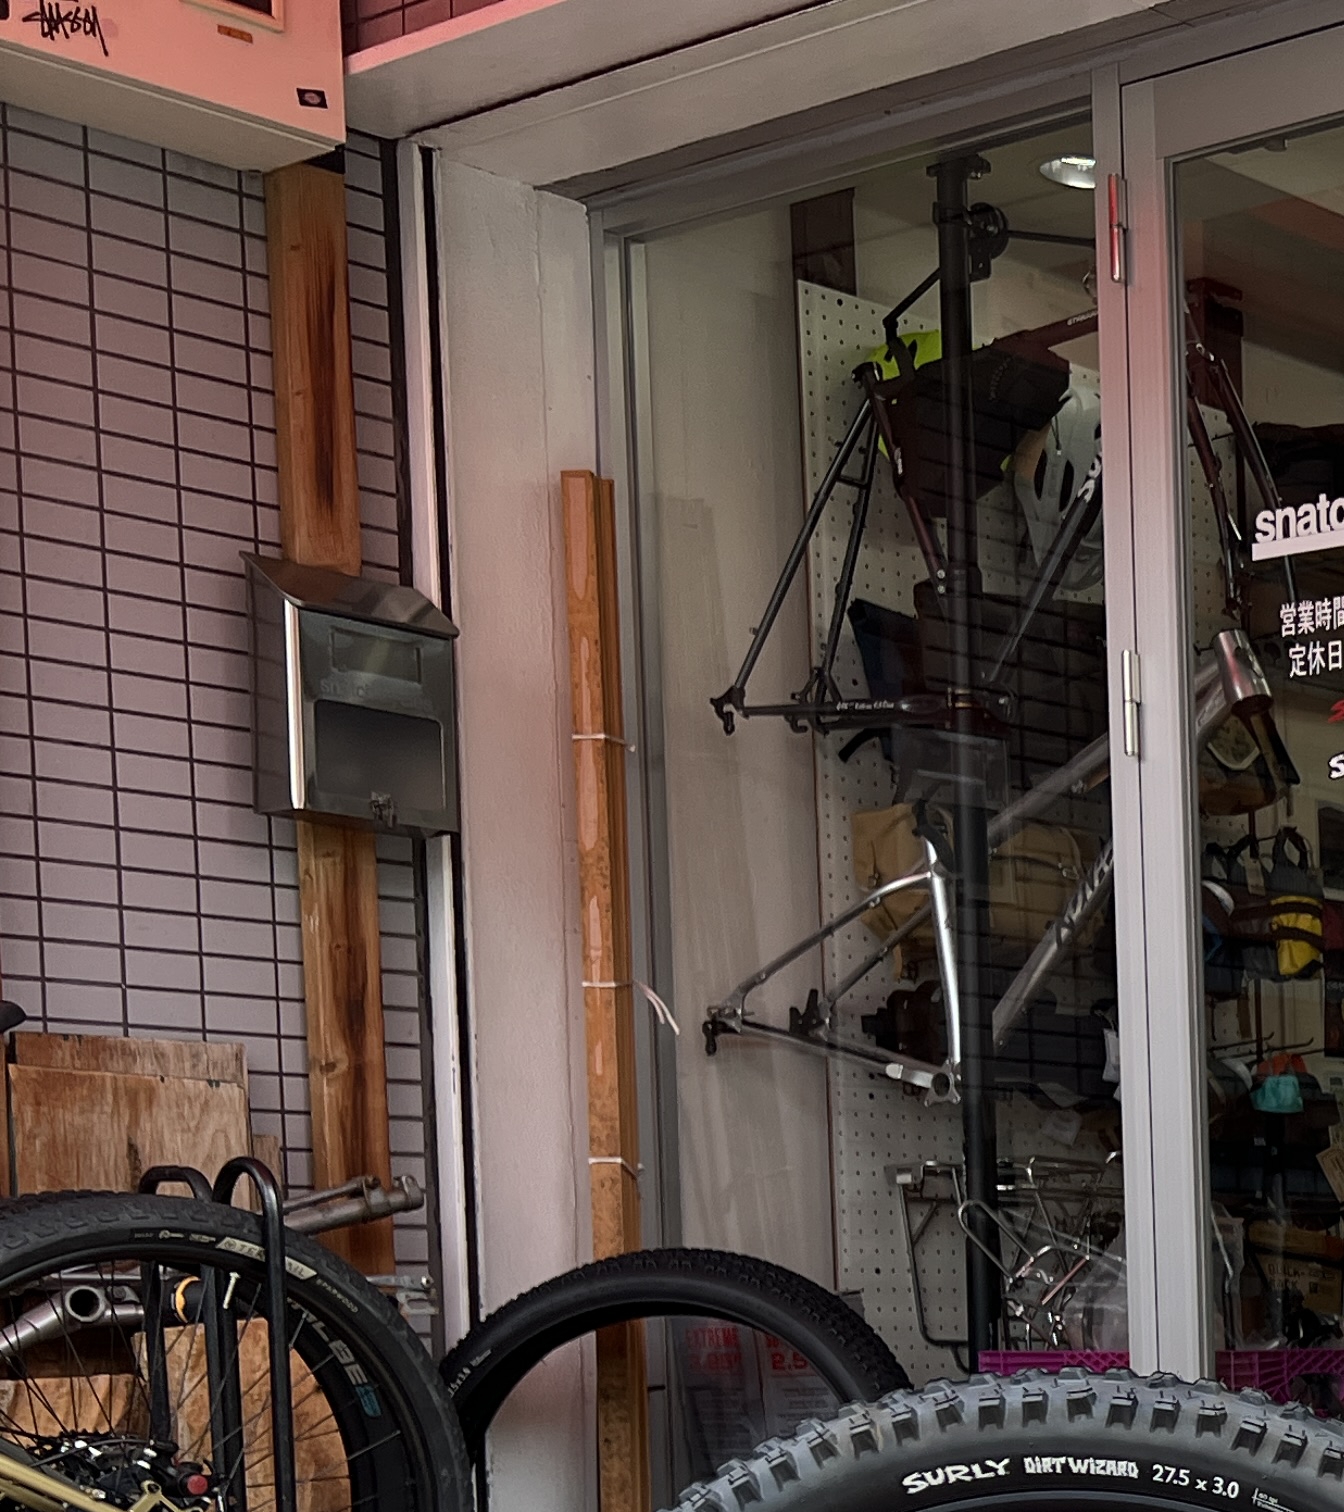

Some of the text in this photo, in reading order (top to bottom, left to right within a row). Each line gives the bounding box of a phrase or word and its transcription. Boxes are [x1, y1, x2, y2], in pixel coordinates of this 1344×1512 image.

[1288, 640, 1343, 679] 定休日
[902, 1457, 1010, 1494] SURLY
[1152, 1464, 1190, 1487] 27.5
[1212, 1476, 1240, 1499] 3.0
